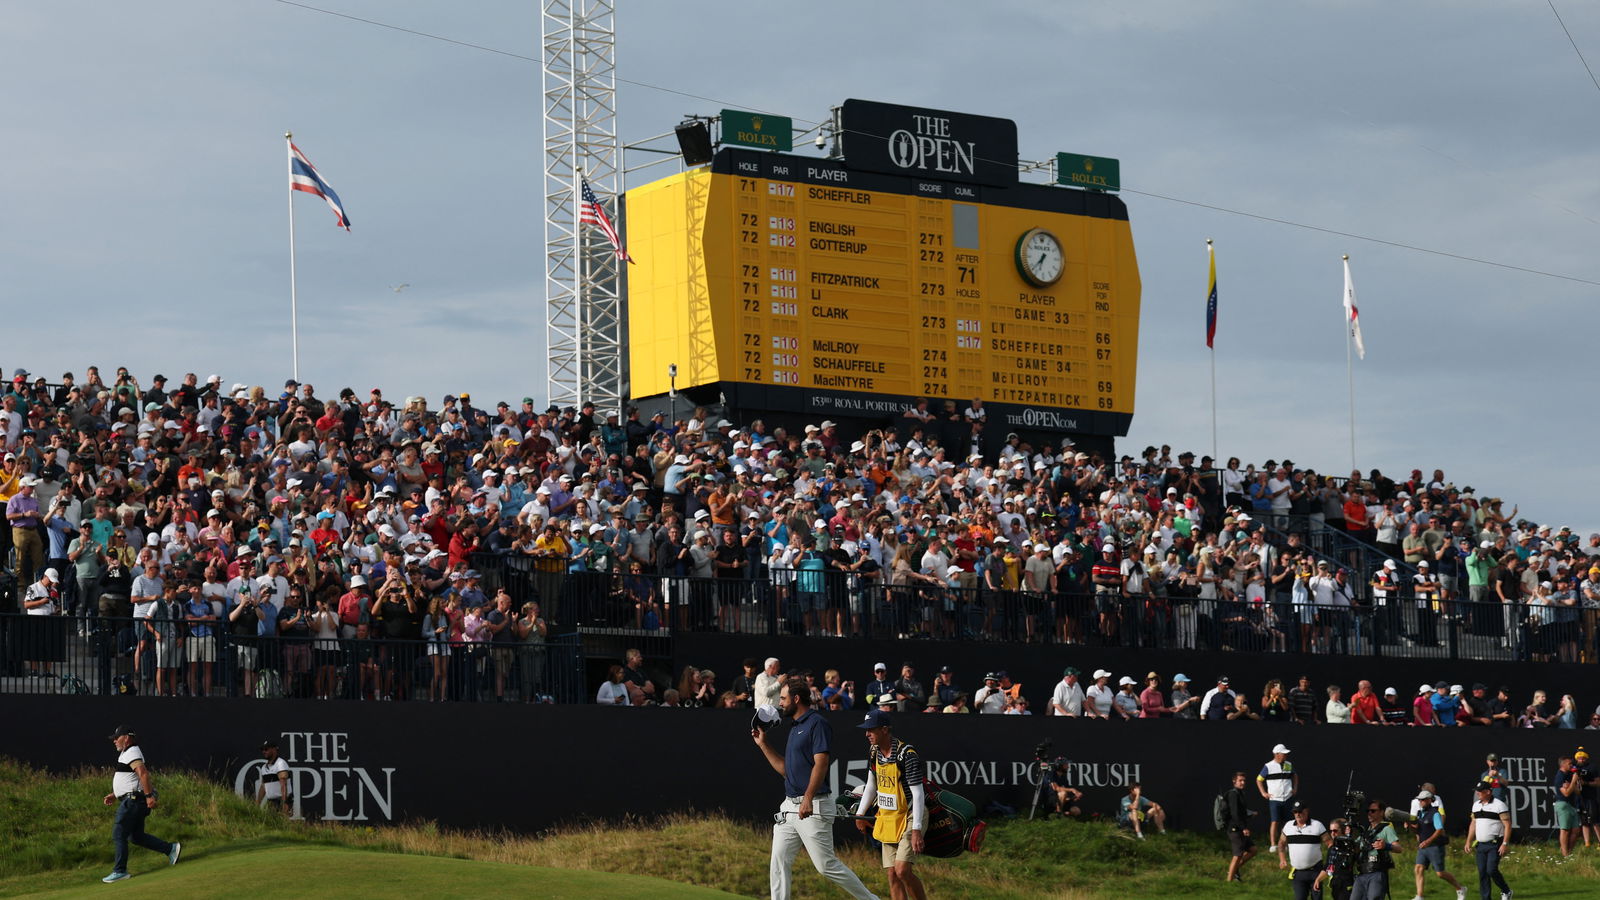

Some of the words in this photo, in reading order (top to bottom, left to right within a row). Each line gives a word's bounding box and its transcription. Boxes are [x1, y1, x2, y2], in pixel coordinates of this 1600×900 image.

[736, 131, 777, 146] ROLEX
[912, 115, 951, 138] THE
[888, 129, 976, 176] OPEN
[738, 162, 758, 172] HOLE
[773, 165, 789, 175] PAR
[807, 167, 848, 182] PLAYER
[918, 183, 942, 193] SCORE
[1071, 173, 1107, 186] ROLEX
[740, 179, 756, 192] 71
[770, 183, 795, 196] -17
[808, 187, 871, 205] SCHEFFLER
[741, 213, 758, 227] 72
[771, 217, 795, 231] -13
[809, 221, 856, 237] ENGLISH
[919, 232, 943, 246] 271
[741, 231, 758, 244] 72
[771, 234, 795, 247] -12
[809, 238, 868, 255] GOTTERUP
[920, 249, 944, 263] 272
[955, 254, 979, 264] AFTER
[742, 265, 759, 278] 72
[772, 269, 796, 281] -11
[811, 272, 880, 289] FITZPATRICK
[921, 282, 945, 296] 273
[957, 266, 976, 284] 71
[743, 282, 759, 295] 71
[772, 286, 797, 299] -11
[811, 289, 821, 300] LI
[956, 289, 980, 299] HOLES
[1019, 293, 1056, 307] PLAYER
[743, 299, 760, 312] 72
[773, 303, 797, 316] -11
[812, 306, 849, 320] CLARK
[922, 316, 946, 329] 273
[1014, 308, 1045, 322] GAME
[1055, 313, 1070, 325] 33
[1095, 301, 1110, 312] RND
[957, 320, 981, 333] -11
[1095, 332, 1111, 345] 66
[744, 334, 761, 347] 72
[773, 337, 798, 350] -10
[813, 340, 859, 355] McILROY
[923, 349, 947, 362] 274
[957, 336, 981, 349] -17
[991, 339, 1063, 356] SCHEFFLER
[1096, 348, 1112, 361] 67
[744, 351, 761, 364] 72
[773, 354, 798, 367] -10
[813, 356, 885, 374] SCHAUFFELE
[923, 366, 947, 379] 274
[1016, 358, 1048, 371] GAME
[1056, 361, 1072, 373] 34
[744, 368, 762, 381] 72
[774, 371, 799, 385] -10
[813, 374, 874, 389] MacINTYRE
[924, 383, 948, 396] 274
[992, 372, 1048, 387] McILROY
[1097, 381, 1113, 393] 69
[834, 398, 864, 411] ROYAL
[865, 401, 914, 413] PORTRUSH
[993, 388, 1080, 406] FITZPATRICK
[1098, 397, 1114, 410] 69
[280, 732, 350, 763] THE
[926, 760, 1005, 786] ROYAL
[1012, 761, 1140, 788] POTRUSH
[1501, 757, 1547, 783] THE
[1474, 785, 1561, 829] PE
